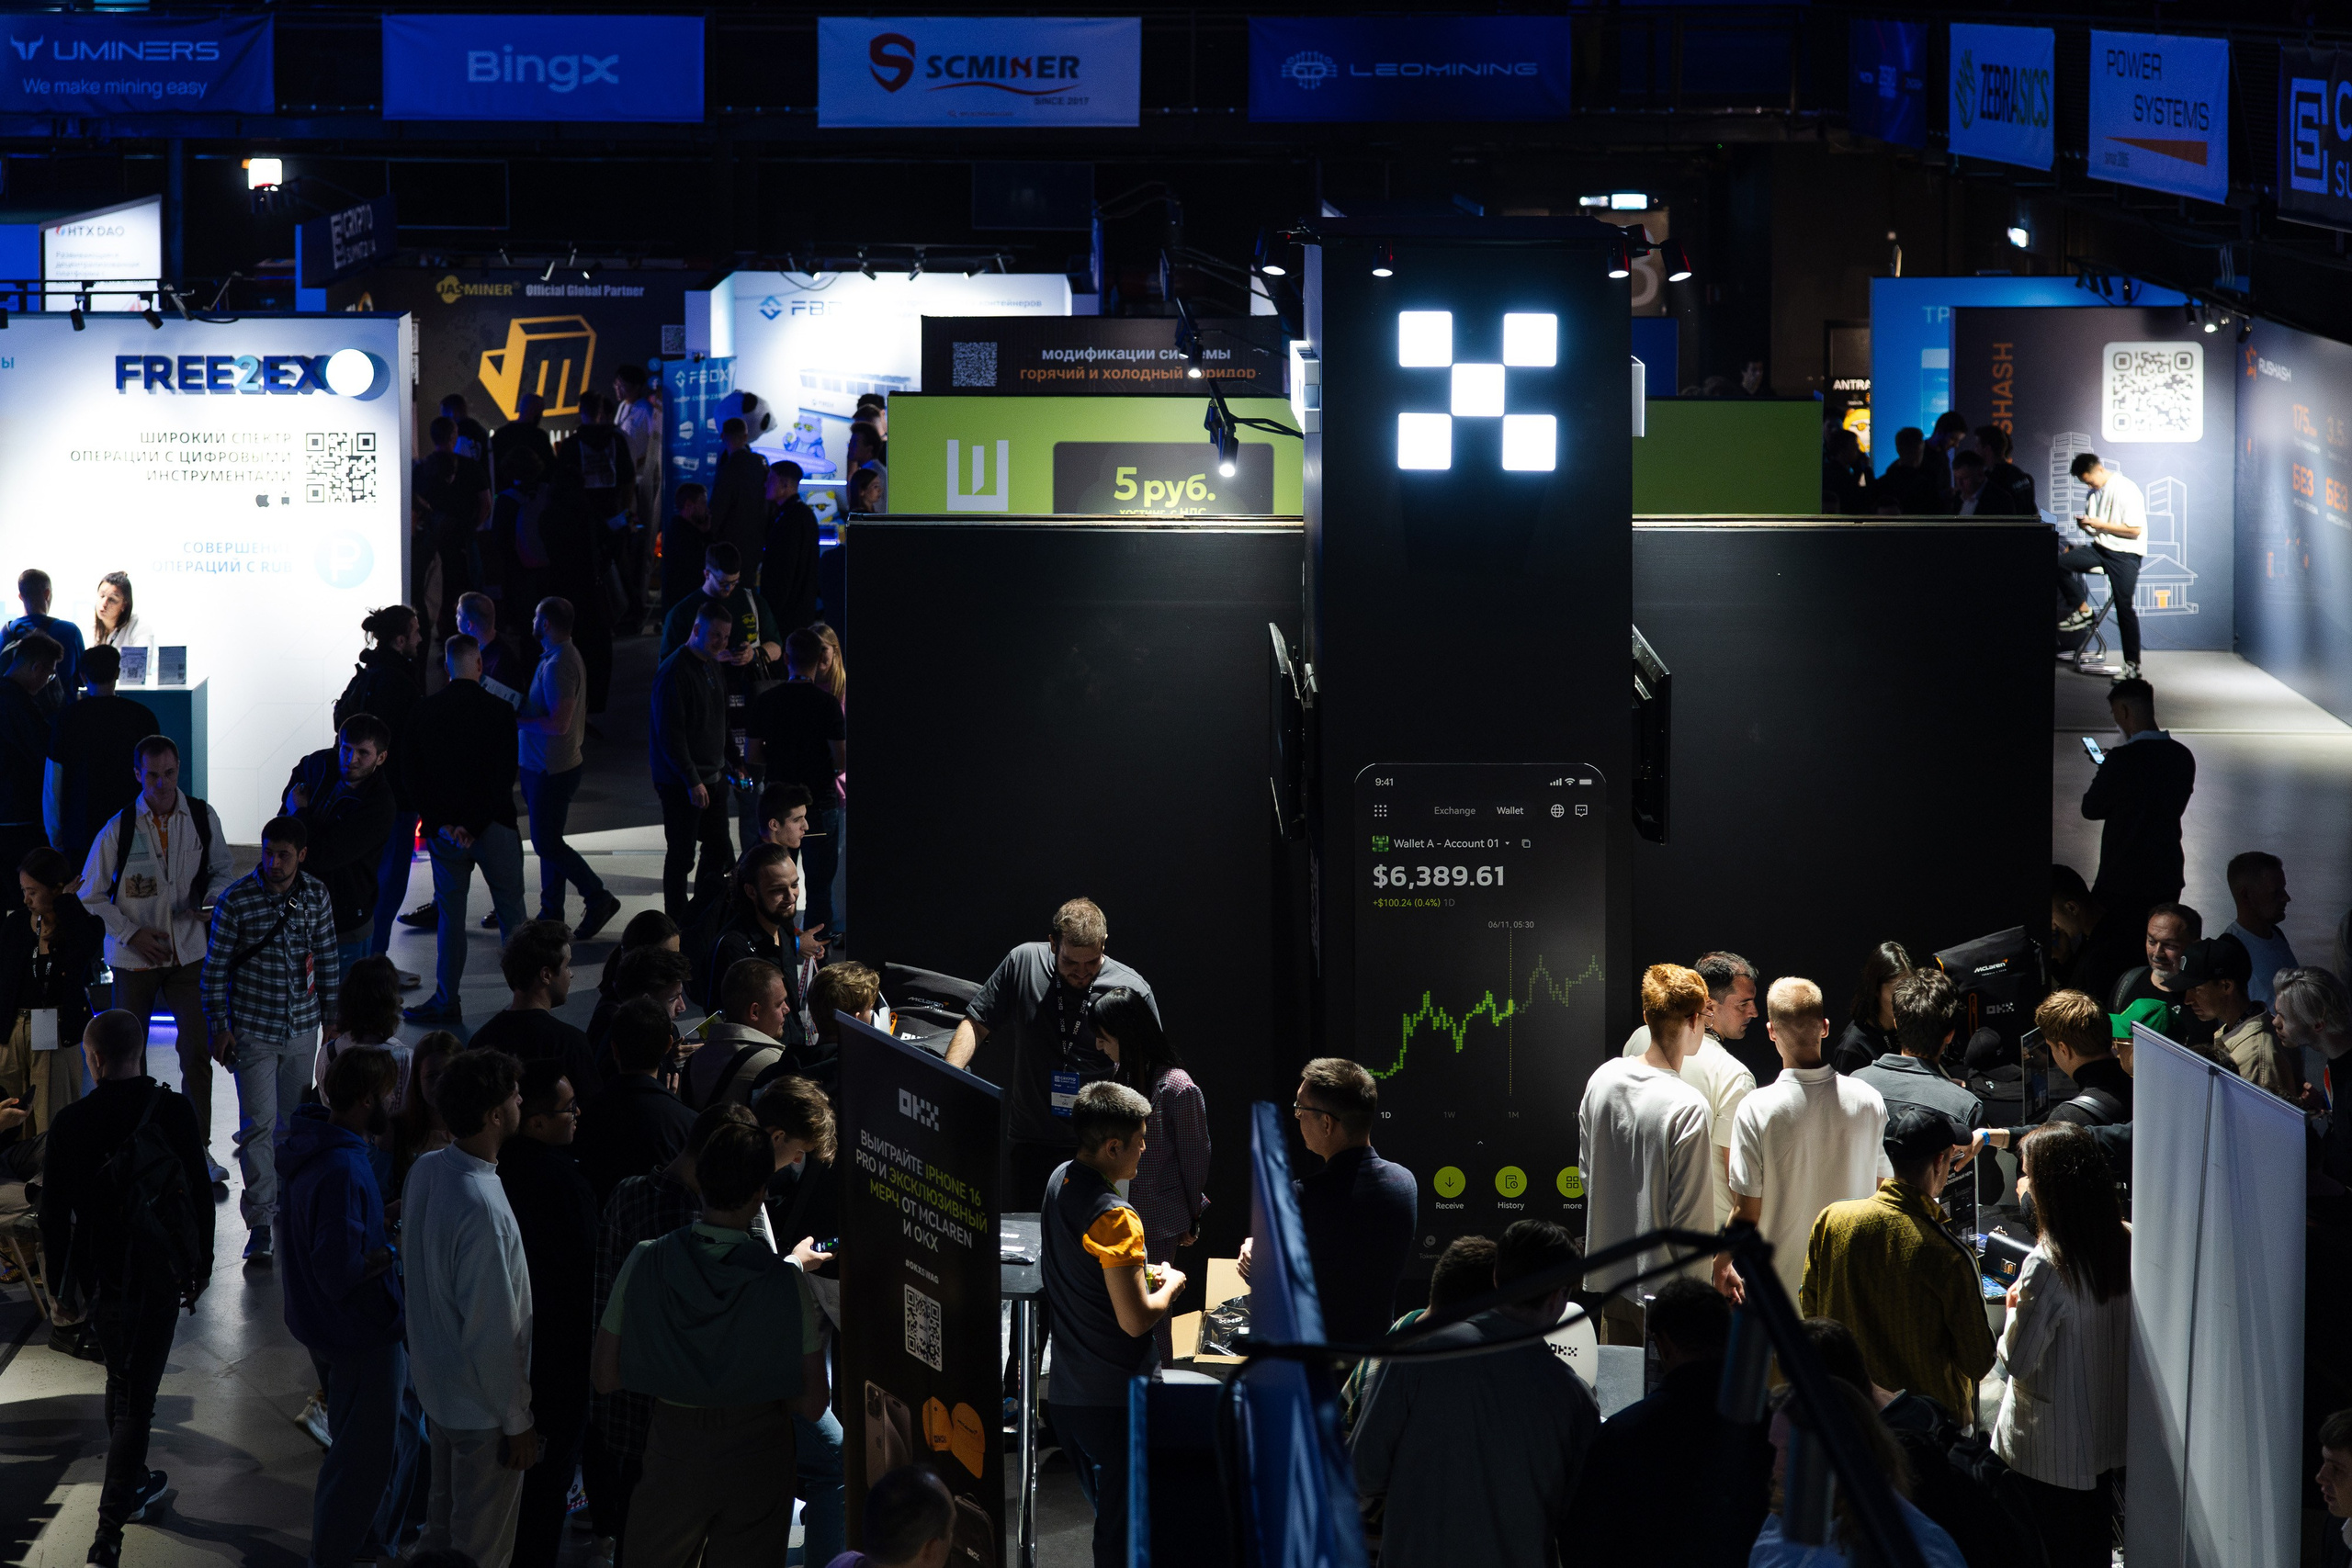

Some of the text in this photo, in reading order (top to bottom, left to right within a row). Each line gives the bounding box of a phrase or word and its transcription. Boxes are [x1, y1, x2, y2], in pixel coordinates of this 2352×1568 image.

[53, 41, 220, 62] UMINERS
[467, 45, 620, 92] Bingx
[926, 55, 1080, 81] SCMINER
[1350, 62, 1538, 76] LEOMINING
[2107, 50, 2163, 81] POWER
[23, 76, 208, 99] We make mining easy
[1035, 96, 1090, 107] SINCE 2017
[1979, 63, 2050, 129] ZEBRASICS
[2133, 95, 2211, 131] SYSTEMS
[68, 225, 125, 237] HTX DAO
[526, 284, 565, 297] Official
[567, 284, 602, 297] Global
[604, 285, 644, 298] Partner
[1042, 346, 1156, 362] модификации
[115, 355, 327, 391] FREE2EX
[1020, 367, 1256, 382] горячий и холодный оридор
[140, 429, 292, 444] ШИРОКИЙ СПЕКТР
[179, 450, 292, 464] ЦИФРОВЫМИ
[146, 469, 292, 481] ИНСТРУМЕНТАМИ
[1114, 467, 1216, 508] 5 руб.
[153, 557, 241, 575] ОПЕРАЦИЙ
[261, 560, 292, 573] RUB
[1374, 777, 1395, 787] 9:41
[1433, 806, 1524, 817] Exchange Wallet
[1394, 838, 1425, 849] Wallet
[1427, 839, 1435, 849] A
[1443, 838, 1485, 849] Account
[1487, 839, 1499, 849] 01
[1373, 863, 1505, 890] $6,389.61
[1373, 897, 1412, 908] +$100.24
[1414, 897, 1442, 908] (0.4%)
[1487, 920, 1535, 930] 06/11, 05:30
[1973, 961, 2007, 974] McLaren
[907, 996, 945, 1009] McLaren
[1380, 1111, 1392, 1120] 1D
[1443, 1111, 1456, 1120] 1W
[1508, 1111, 1520, 1120] 1M
[860, 1129, 982, 1208] ВЫИГРАЙТЕ IPHONE 16
[855, 1148, 989, 1234] PRO И ЭКСКЛЮЗИВНЫЙ
[869, 1178, 973, 1249] МЕРЧ ОТ MCLAREN
[1435, 1201, 1583, 1212] Receive History more
[902, 1218, 911, 1239] И
[905, 1258, 940, 1285] #OKXSWAG
